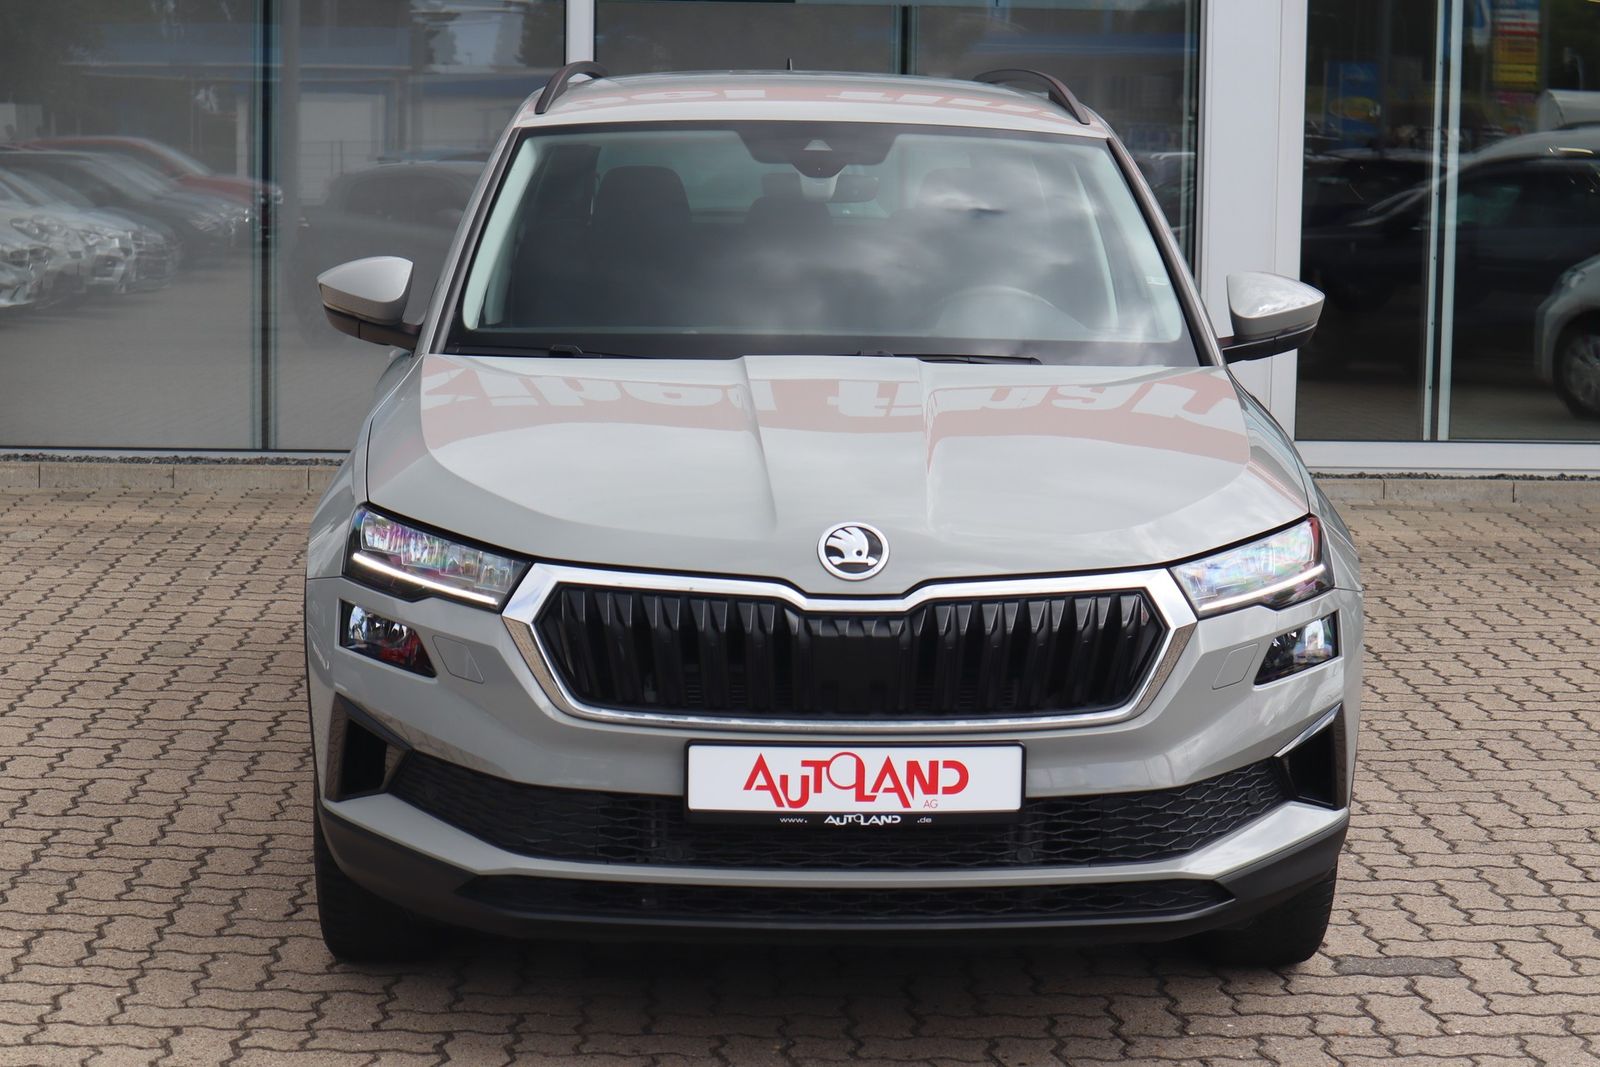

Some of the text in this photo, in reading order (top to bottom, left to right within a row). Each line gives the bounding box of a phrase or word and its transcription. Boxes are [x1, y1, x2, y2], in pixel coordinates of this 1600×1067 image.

[743, 752, 969, 809] AUTOLAND
[923, 799, 938, 809] AG
[824, 813, 901, 826] AUTOLAND
